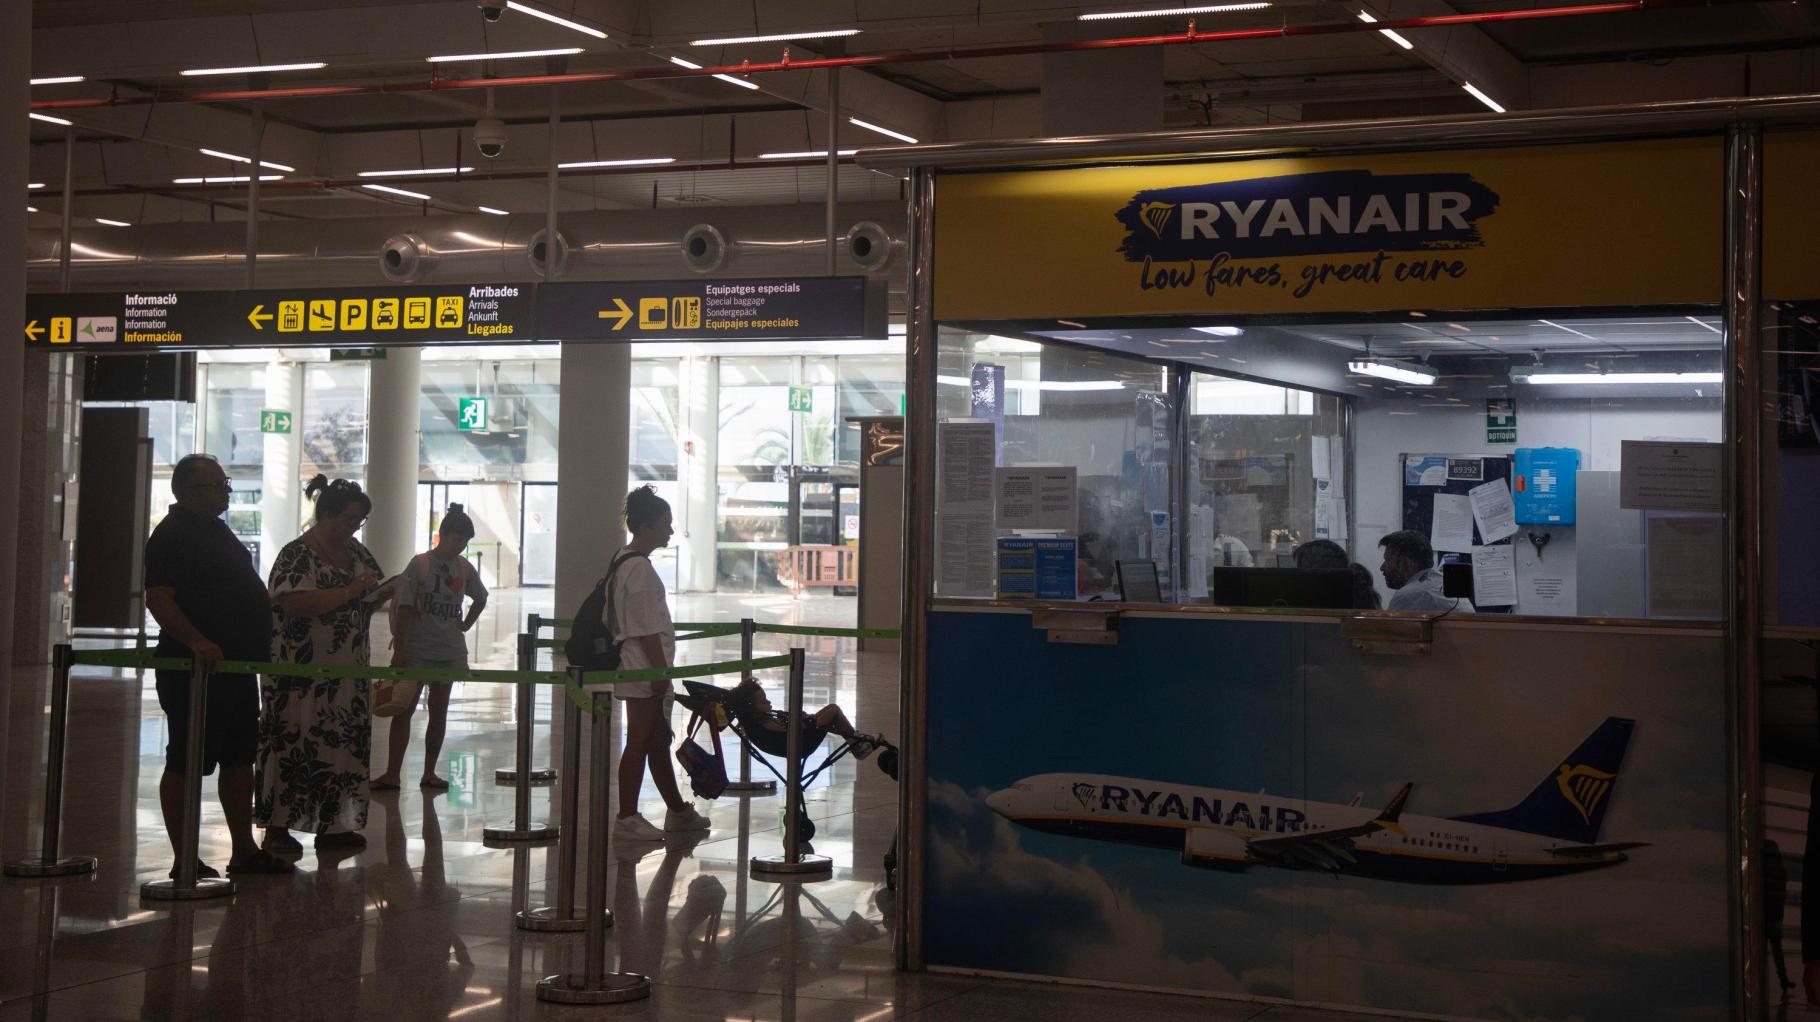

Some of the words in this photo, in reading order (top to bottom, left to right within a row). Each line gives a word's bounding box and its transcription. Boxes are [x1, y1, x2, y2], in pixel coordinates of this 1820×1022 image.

[1180, 190, 1472, 241] RYANAIR
[1140, 254, 1196, 291] Low
[1203, 252, 1288, 297] fares,
[1292, 249, 1393, 299] great
[1395, 256, 1468, 285] care
[468, 286, 519, 298] Arribades
[706, 285, 756, 295] Equipatges
[758, 283, 800, 294] especials
[125, 293, 177, 305] Informació
[441, 298, 459, 306] TAXI
[468, 299, 499, 310] Arrivals
[706, 297, 732, 307] Special
[733, 297, 765, 306] baggage
[125, 307, 167, 317] Information
[347, 305, 362, 326] P
[468, 311, 499, 322] Ankunft
[706, 308, 757, 318] Sondergepäck
[95, 325, 114, 333] aena
[125, 319, 167, 329] Information
[467, 323, 514, 336] Llegadas
[705, 319, 749, 330] Equipajes
[751, 318, 799, 329] especiales
[124, 331, 182, 342] Información
[432, 574, 440, 593] I
[424, 592, 463, 621] BEATLE
[1101, 784, 1306, 833] RYANAIR
